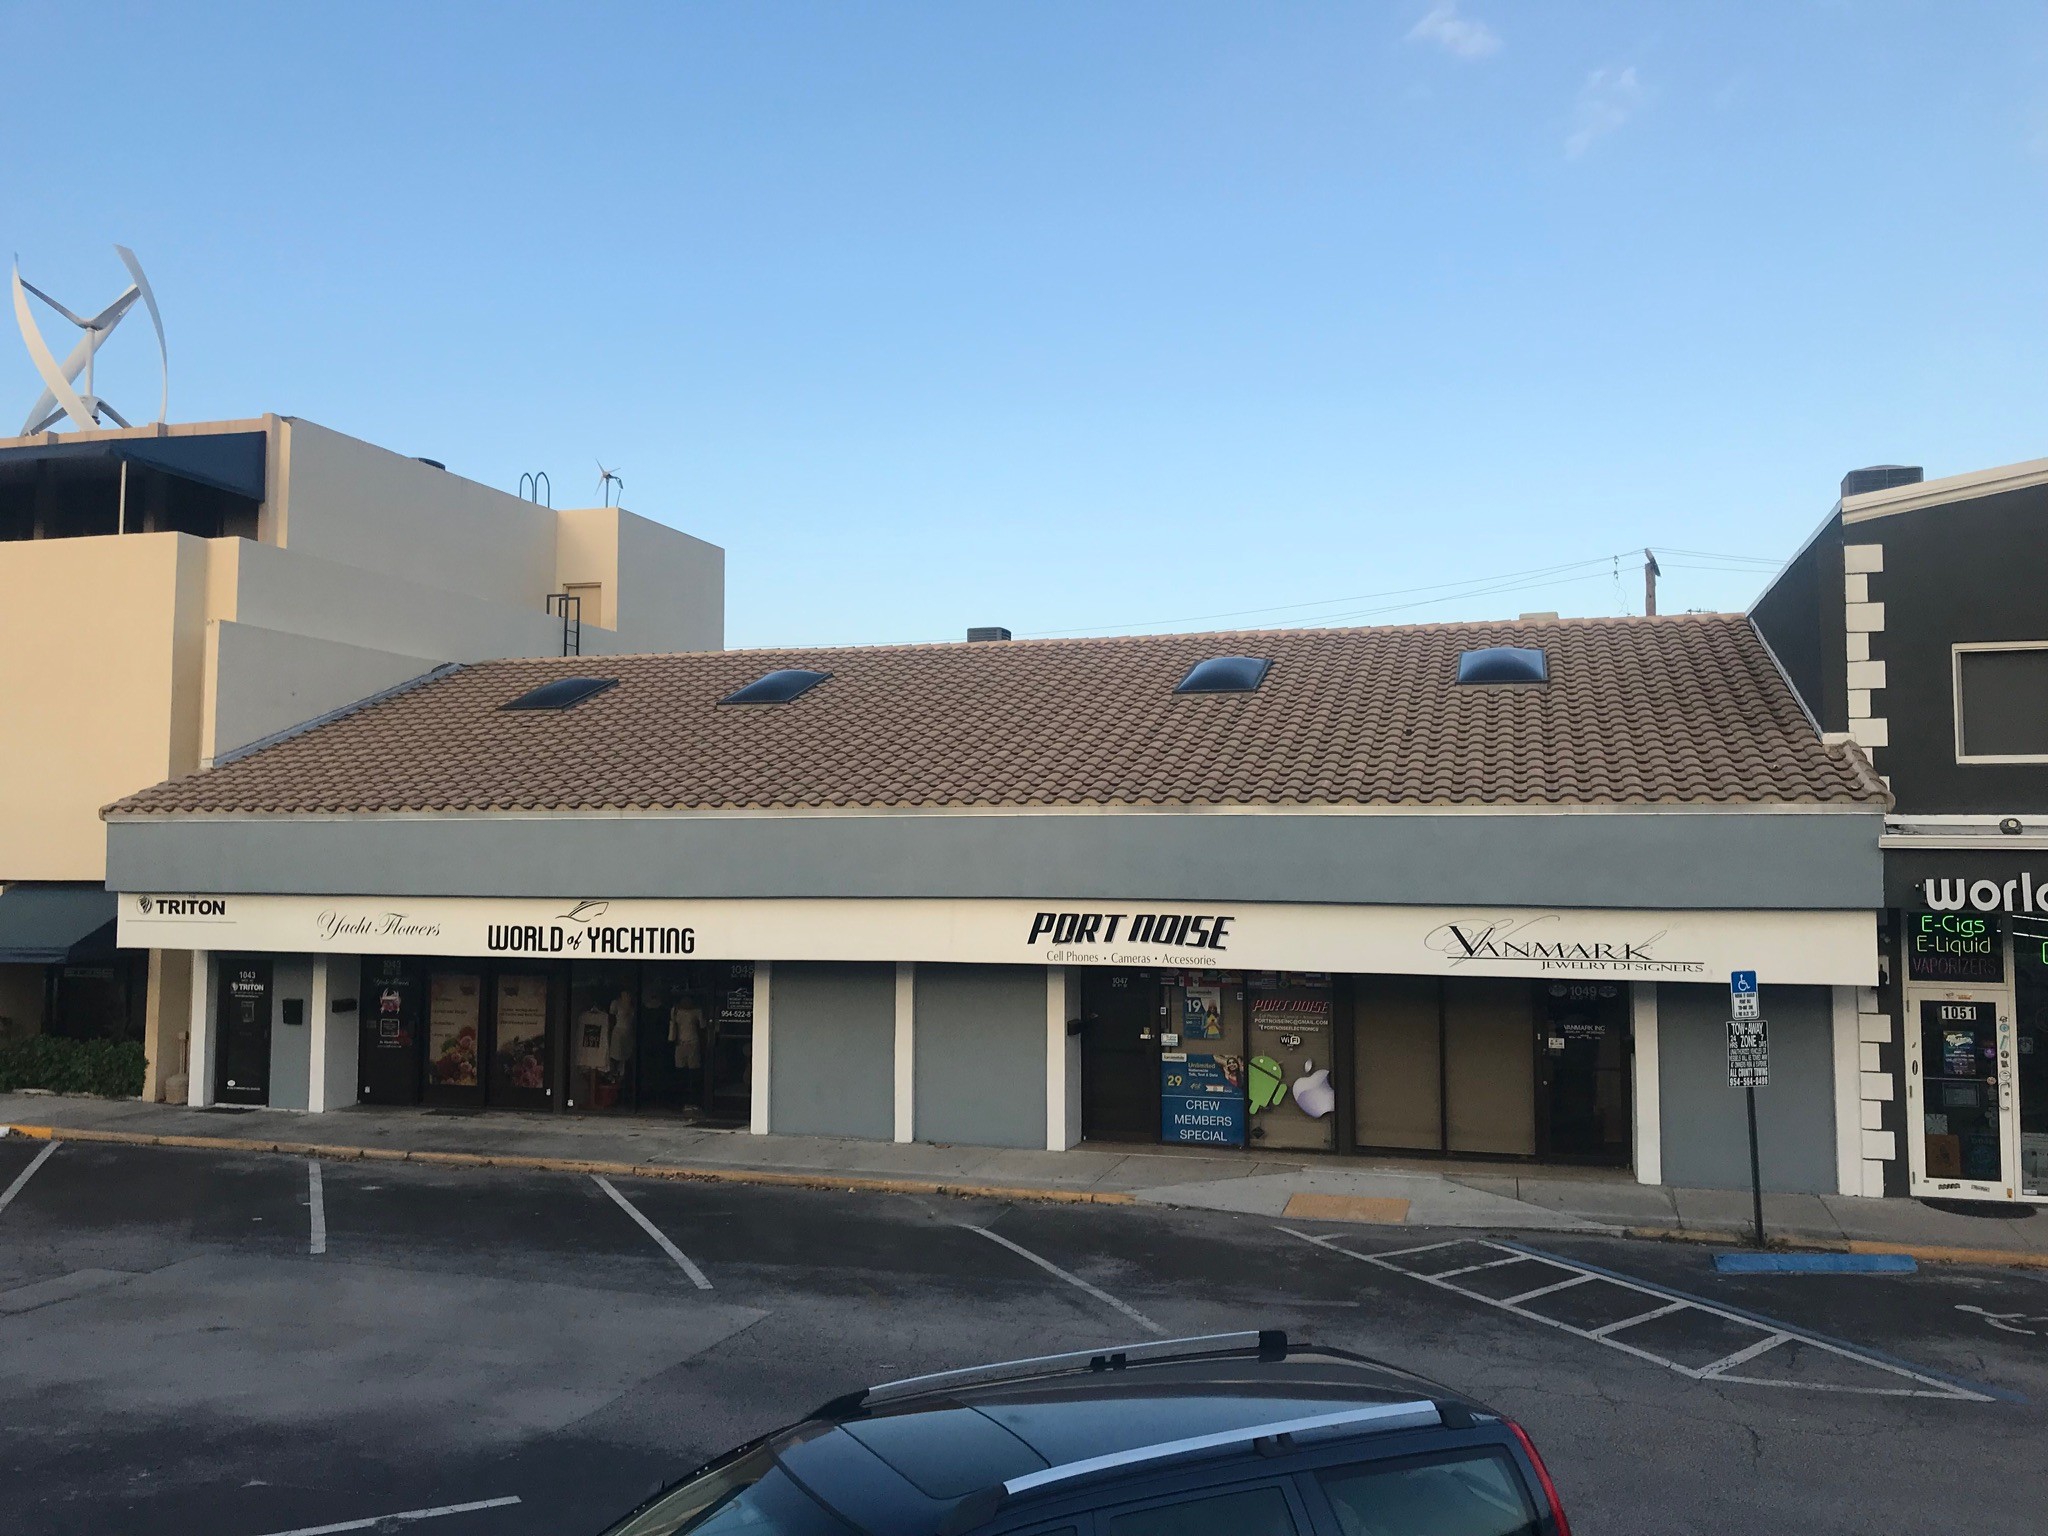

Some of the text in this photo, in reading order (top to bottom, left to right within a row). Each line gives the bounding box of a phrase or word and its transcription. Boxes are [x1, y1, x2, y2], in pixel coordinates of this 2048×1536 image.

[156, 900, 225, 915] TRITON
[316, 909, 440, 941] Yacht Flowers
[1027, 912, 1235, 951] PORT NOISE
[1921, 915, 1986, 938] E-Cigs
[488, 925, 695, 954] WORLD of YACHTING
[1448, 925, 1653, 961] VANMARK
[1916, 935, 1991, 957] E-Liquid
[1046, 951, 1216, 966] Cell Phones Cameras Accessories
[1541, 961, 1608, 971] JEWELRY
[1913, 957, 1997, 975] VAPORIZERS
[239, 971, 256, 979] 1043
[239, 984, 264, 992] TRITON
[1570, 986, 1597, 996] 1049
[1187, 1000, 1201, 1013] 19
[1253, 1000, 1329, 1014] PORT NOISE
[1943, 1006, 1975, 1019] 1051
[1168, 1075, 1182, 1087] 29
[1186, 1100, 1220, 1111] CREW
[1174, 1114, 1232, 1127] MEMBERS
[1179, 1129, 1228, 1142] SPECIAL
